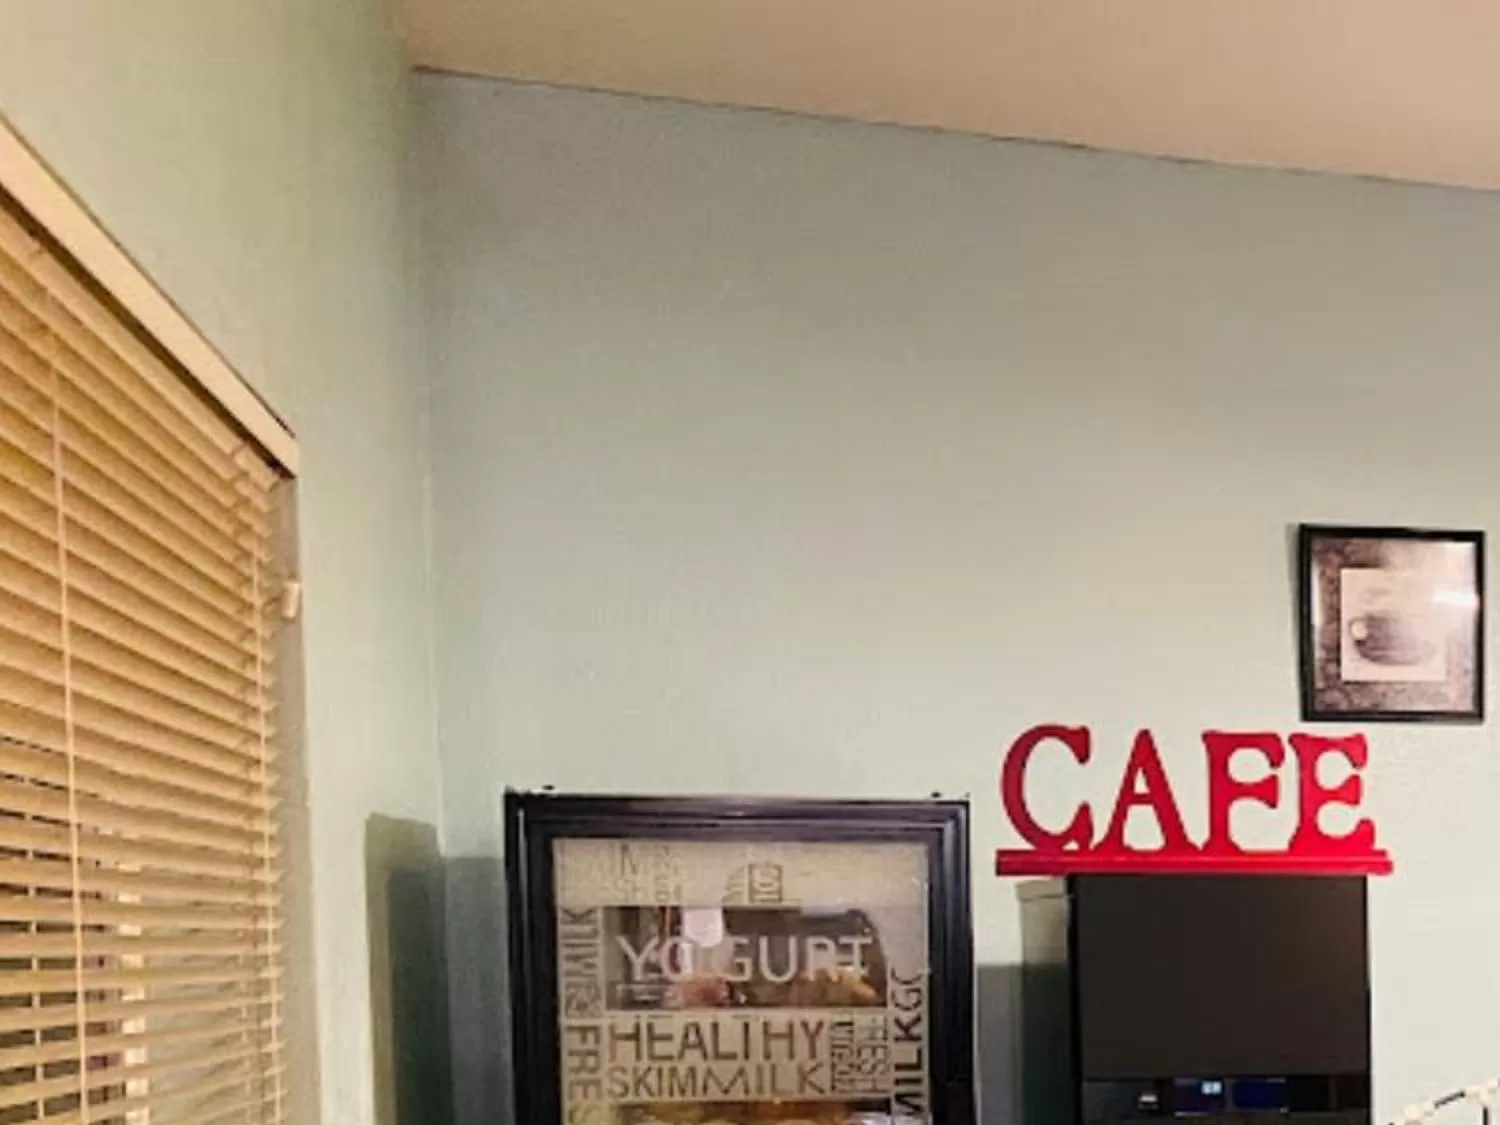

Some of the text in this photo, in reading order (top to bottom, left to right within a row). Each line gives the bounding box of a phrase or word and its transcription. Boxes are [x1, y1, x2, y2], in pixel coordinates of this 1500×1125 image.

[1001, 723, 1376, 852] CAFE
[615, 933, 876, 983] YOGURT
[608, 1018, 827, 1063] HEALTHY
